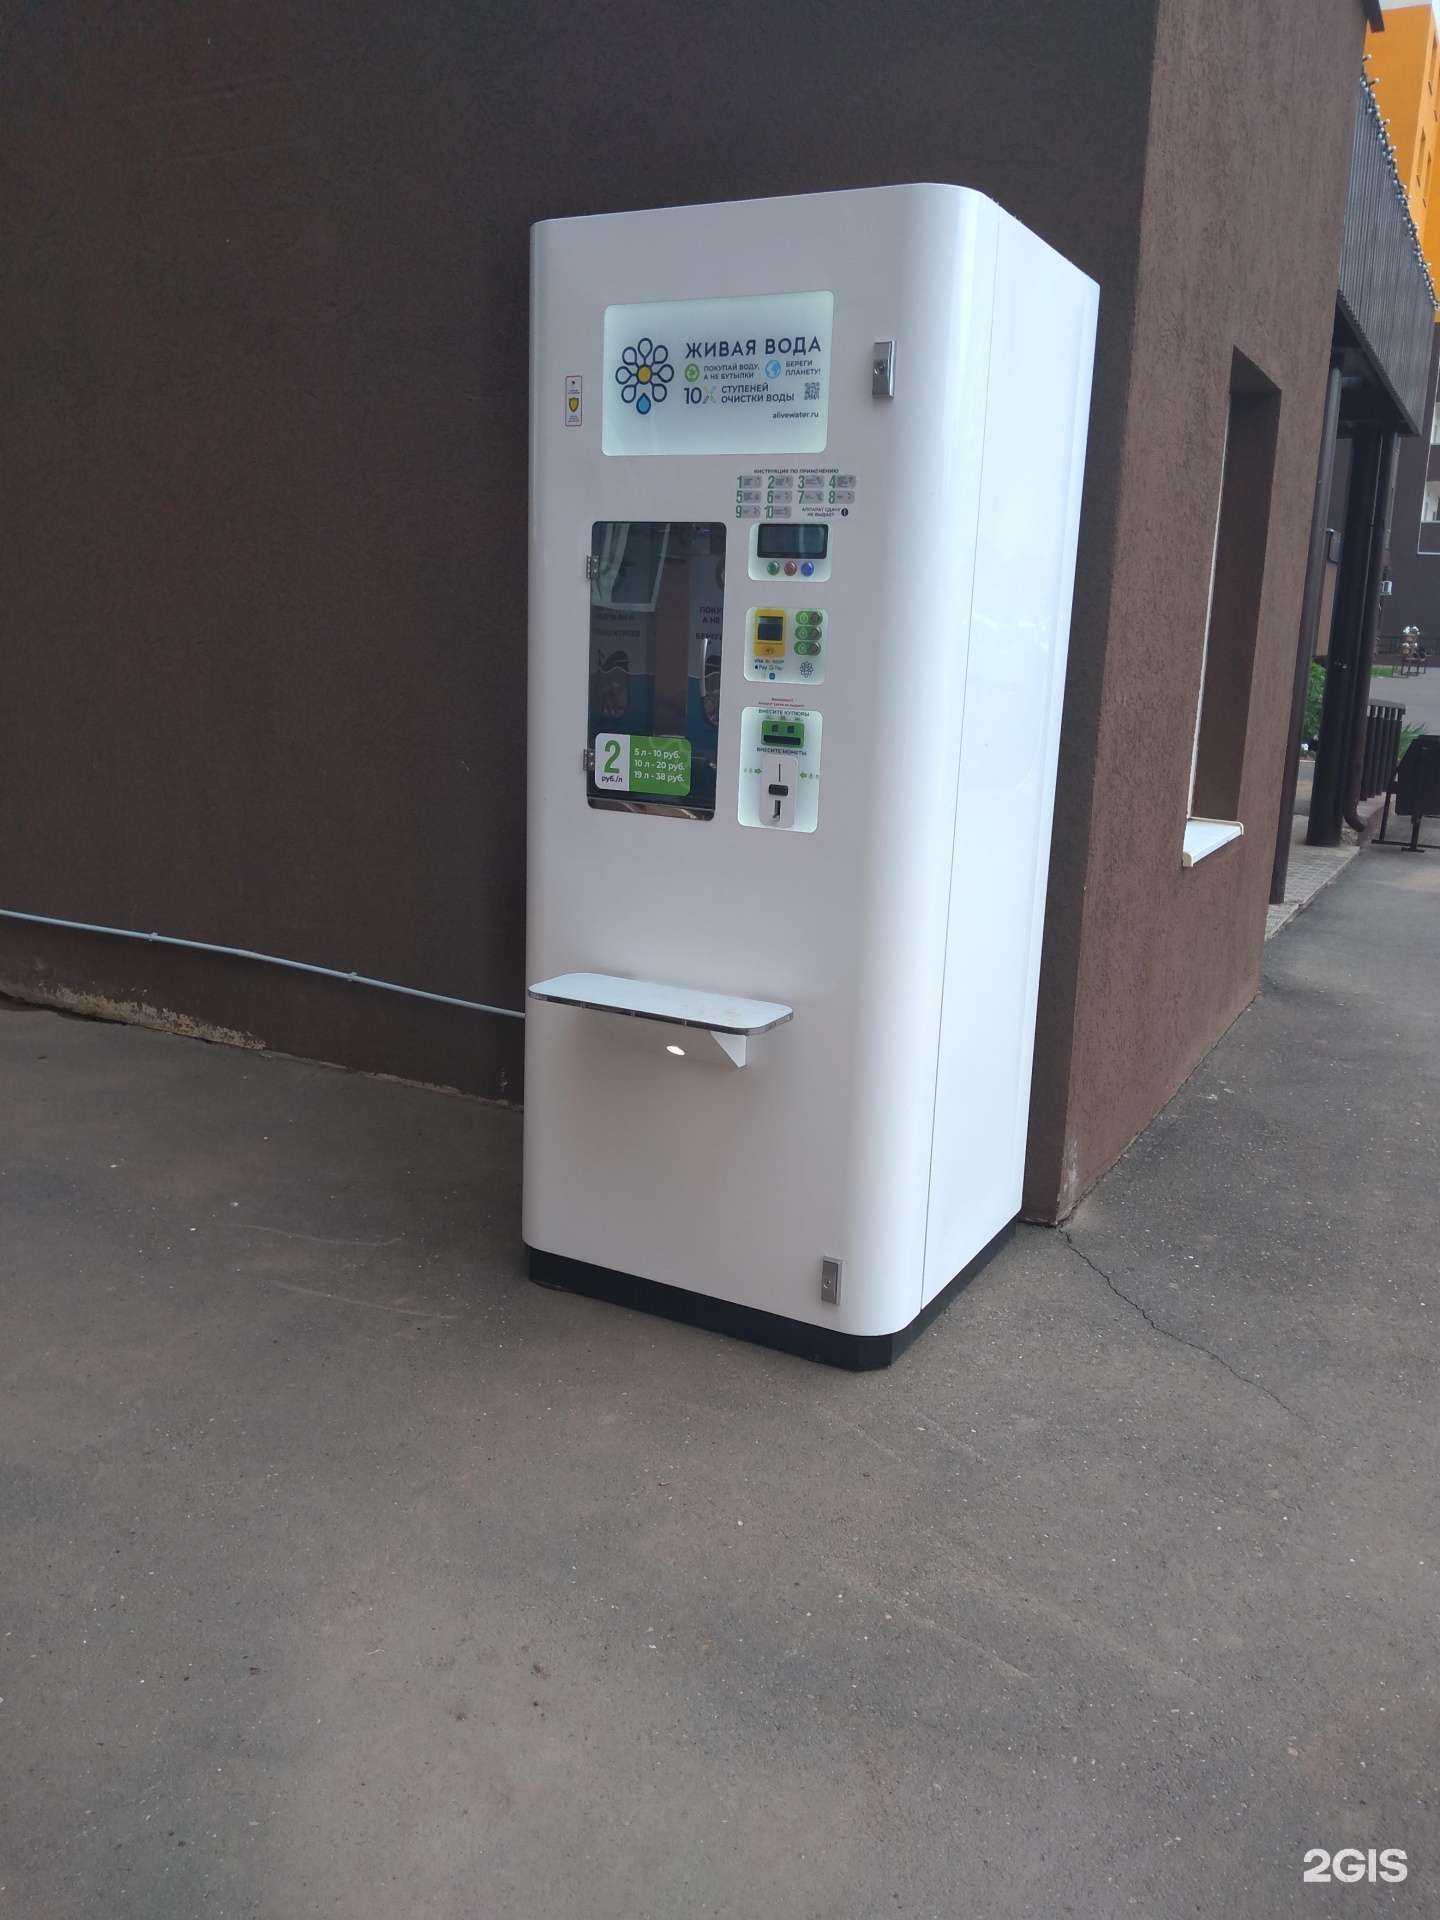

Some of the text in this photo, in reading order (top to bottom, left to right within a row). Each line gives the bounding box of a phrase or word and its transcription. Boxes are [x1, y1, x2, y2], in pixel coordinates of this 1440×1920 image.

[685, 336, 821, 359] ЖИВАЯ ВОДА
[704, 363, 738, 372] ПОКУПАЙ
[786, 368, 821, 376] ПЛАНЕТУ!
[721, 382, 769, 393] СТУПЕНЕЙ
[721, 392, 794, 404] ОЧИСТКИ ВОДЫ
[736, 476, 742, 489] 1
[768, 476, 774, 489] 2
[798, 476, 804, 489] 3
[829, 476, 836, 489] 4
[736, 490, 742, 504] 5
[767, 490, 774, 504] 6
[798, 490, 804, 504] 7
[828, 490, 835, 504] 8
[736, 505, 742, 518] 9
[764, 506, 774, 518] 10
[604, 740, 620, 774] 2
[654, 750, 662, 758] 10
[663, 750, 680, 760] руб.
[634, 760, 642, 768] 10
[656, 761, 666, 769] 20
[668, 762, 685, 772] руб.
[602, 775, 622, 784] руб./л
[634, 771, 642, 779] 19
[656, 772, 666, 780] 38
[668, 774, 685, 782] руб.
